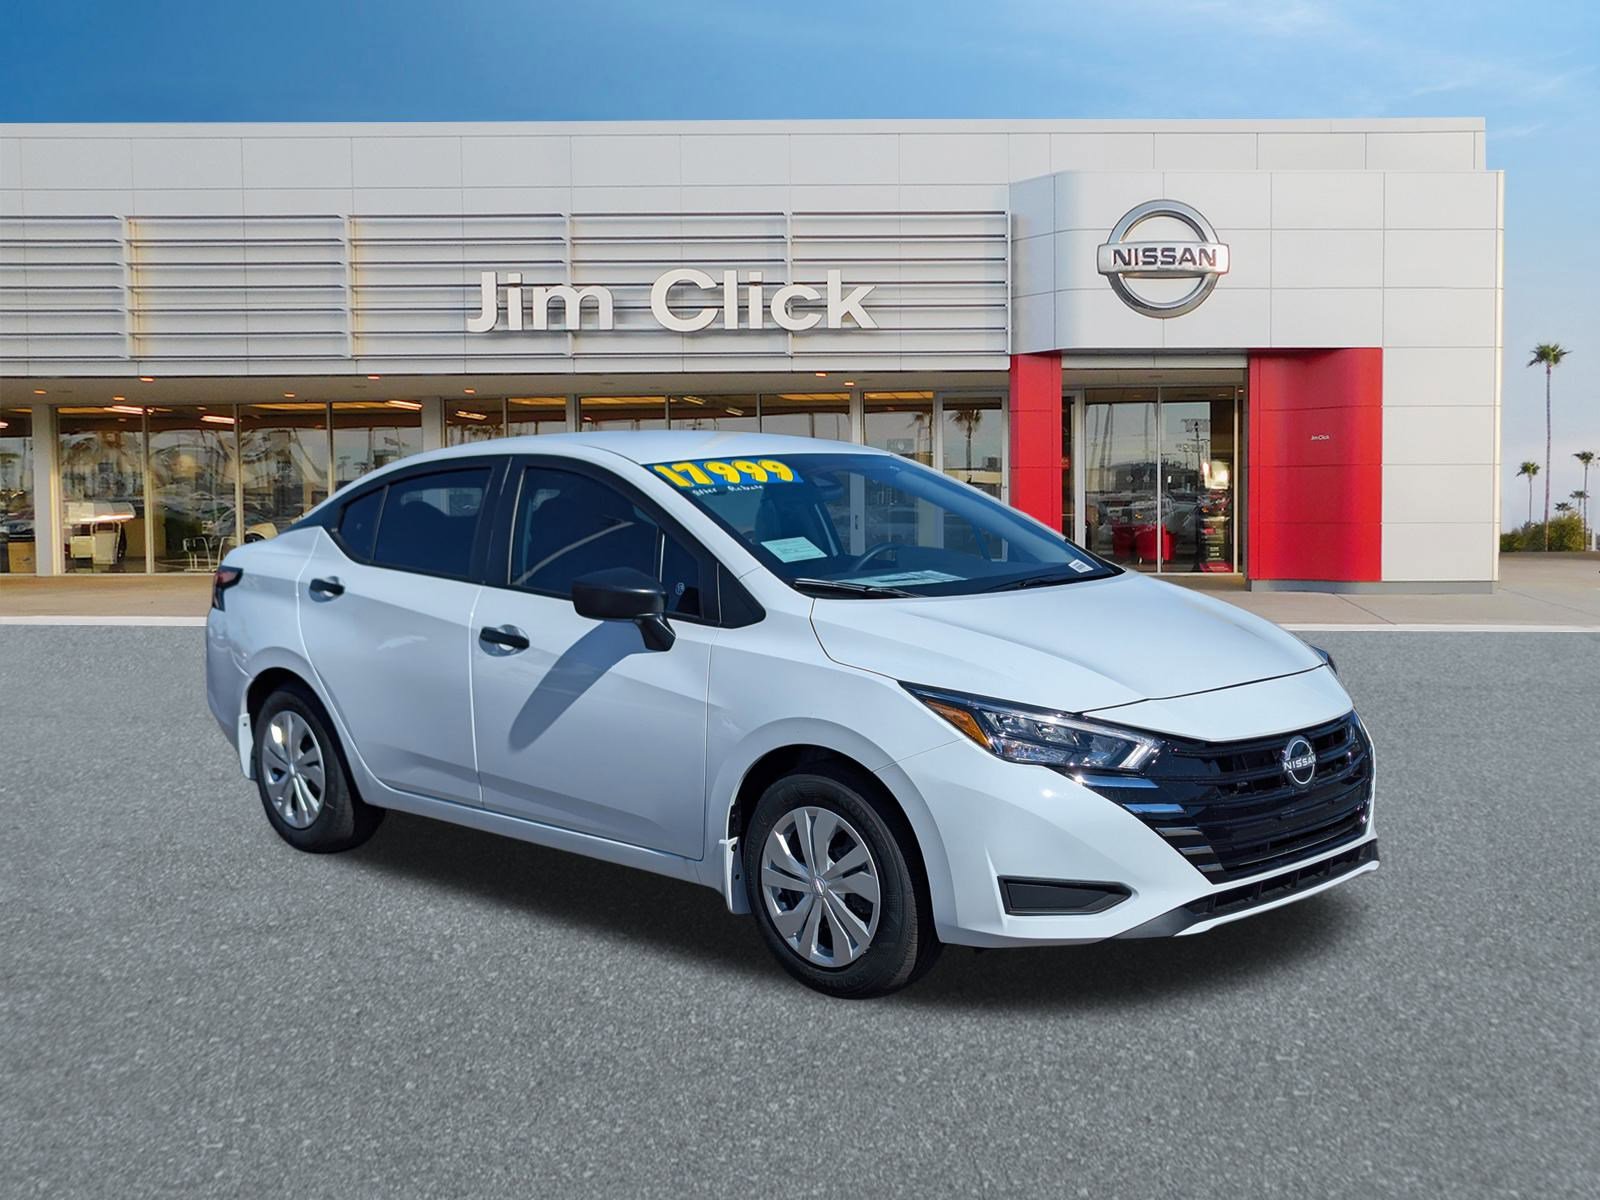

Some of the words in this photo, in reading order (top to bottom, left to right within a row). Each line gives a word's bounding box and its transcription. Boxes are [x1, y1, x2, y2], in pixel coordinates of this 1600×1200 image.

[1112, 247, 1217, 267] NISSAN
[467, 271, 614, 333] Jim
[651, 268, 879, 333] Click
[654, 459, 795, 488] 17999
[1283, 753, 1317, 771] NISSAN
